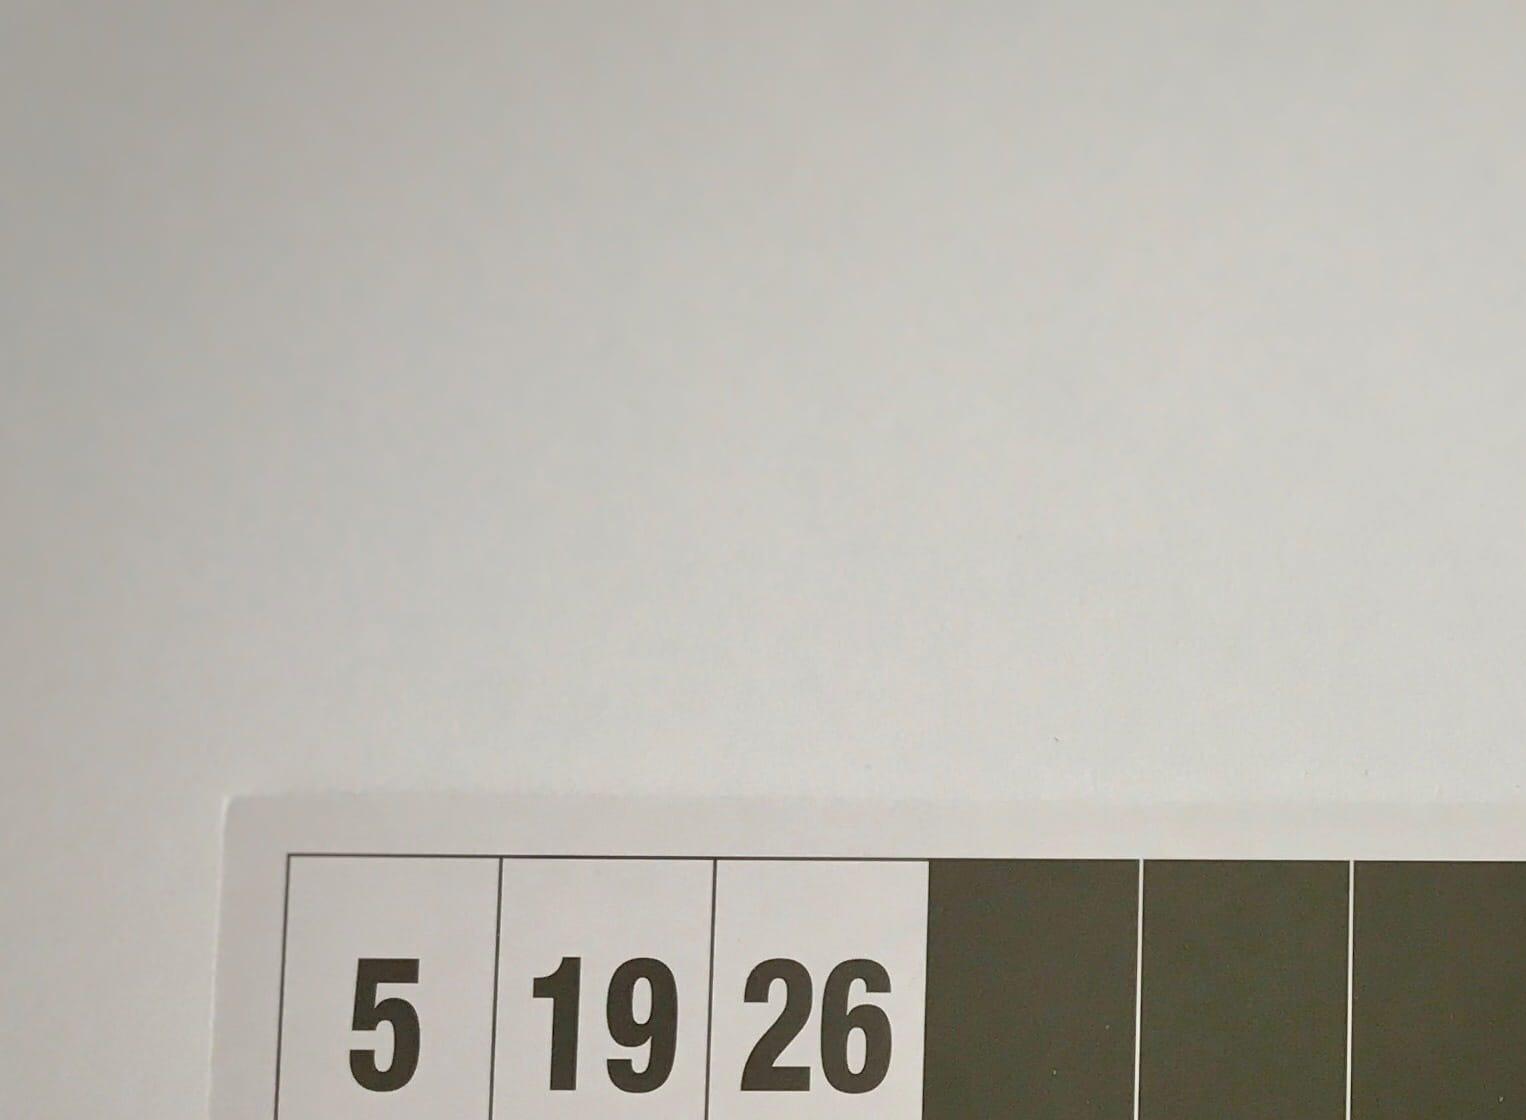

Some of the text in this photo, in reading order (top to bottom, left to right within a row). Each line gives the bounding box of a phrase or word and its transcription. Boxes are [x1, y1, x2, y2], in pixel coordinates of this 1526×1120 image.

[350, 958, 420, 1093] 5
[533, 957, 677, 1093] 19
[741, 958, 891, 1094] 26
